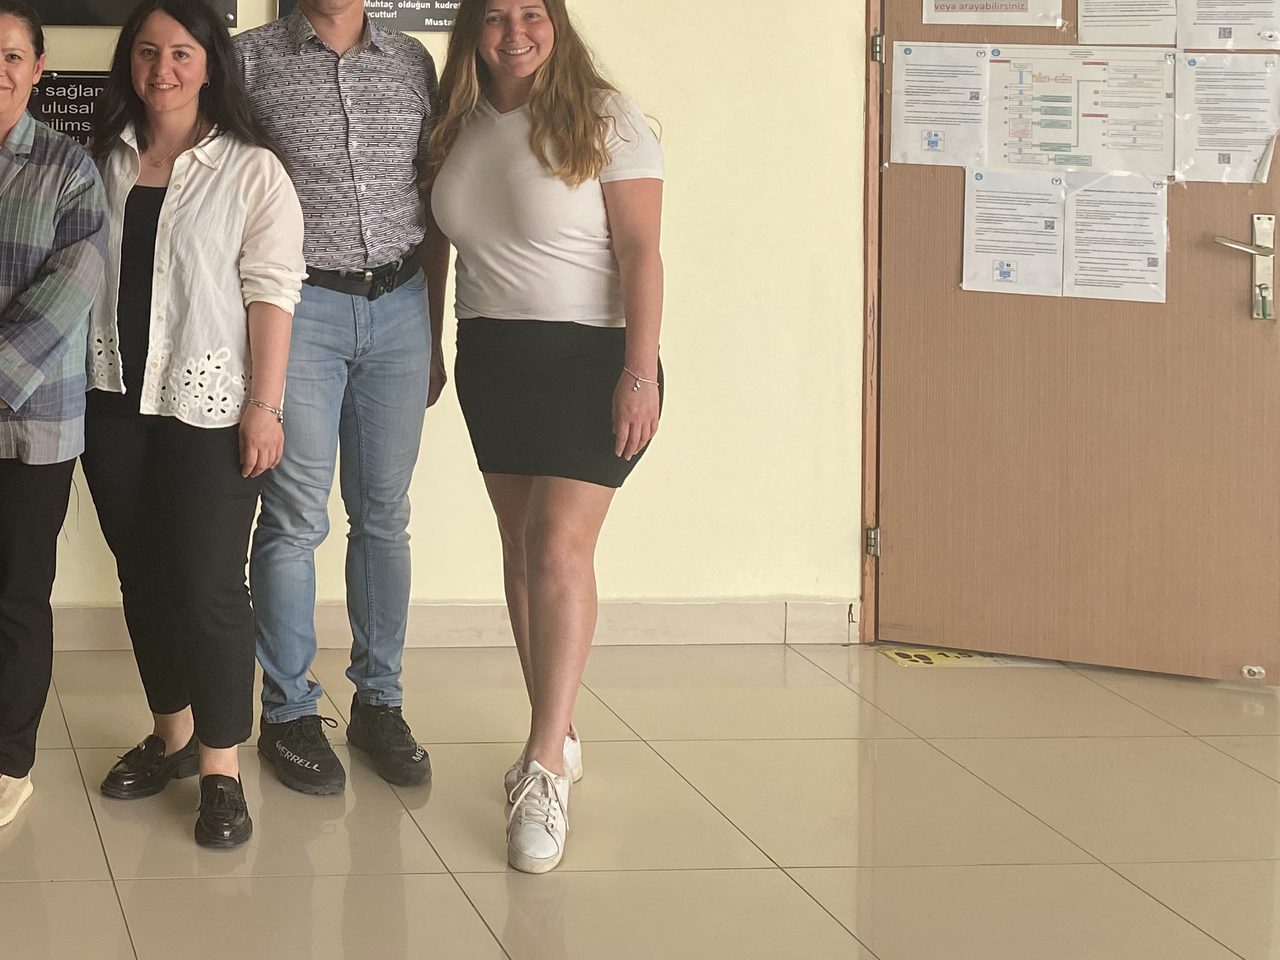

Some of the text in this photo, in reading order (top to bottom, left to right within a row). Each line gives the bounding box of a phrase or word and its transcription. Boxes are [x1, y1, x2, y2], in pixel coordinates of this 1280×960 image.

[935, 3, 956, 12] veya
[424, 16, 452, 26] Musta
[42, 101, 94, 114] ulusal
[275, 740, 321, 772] MERRELL
